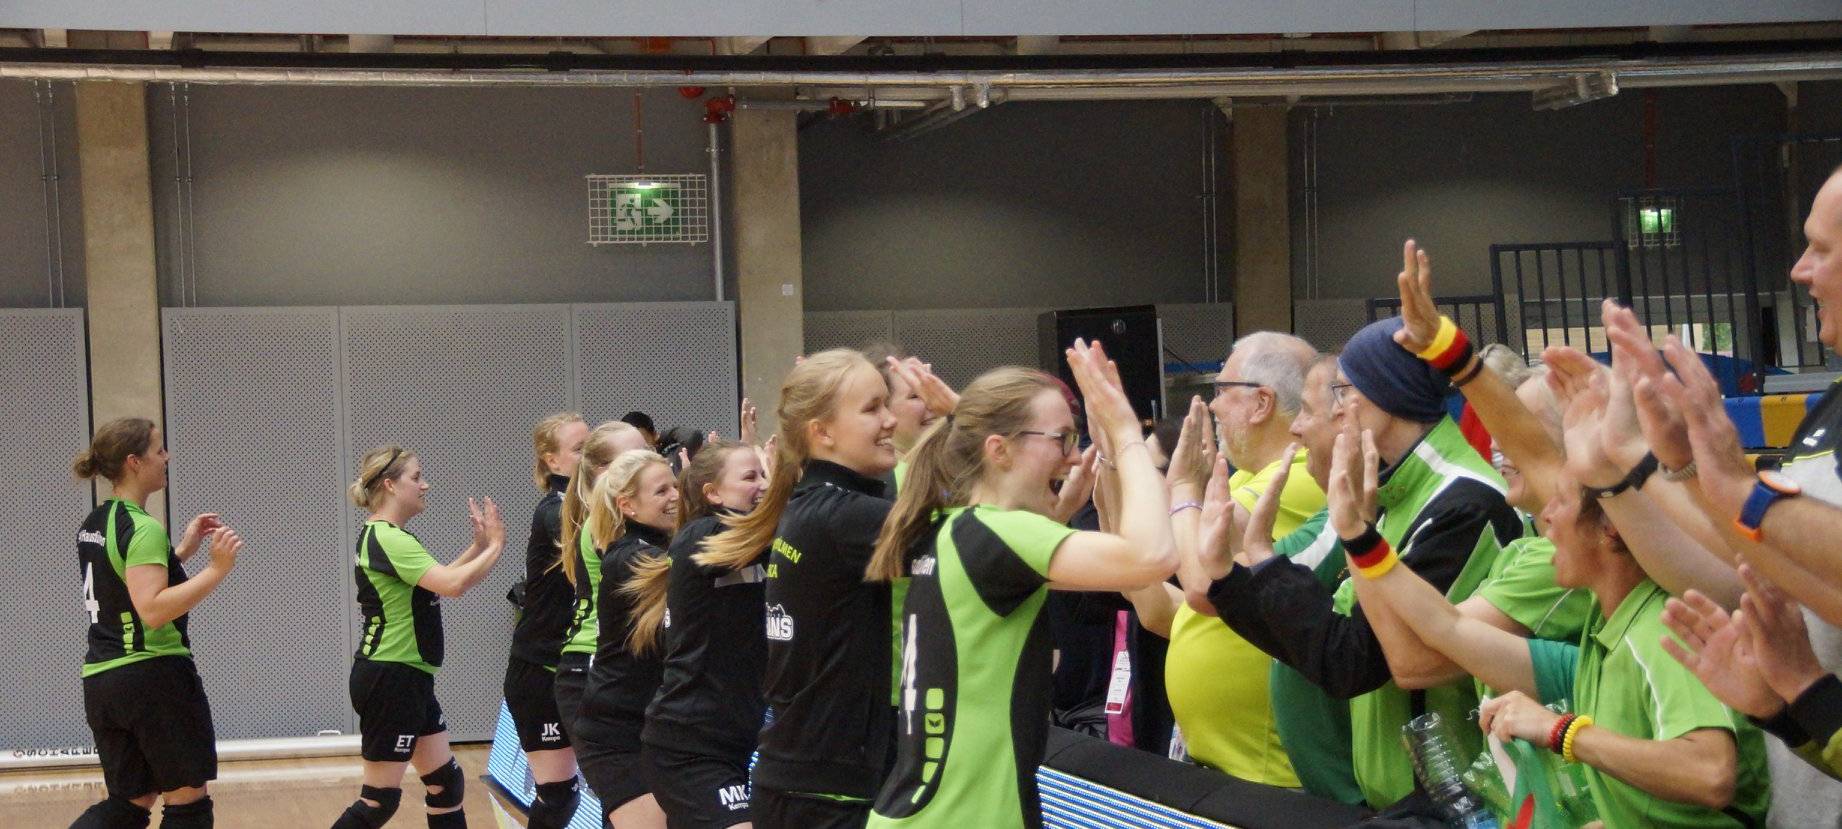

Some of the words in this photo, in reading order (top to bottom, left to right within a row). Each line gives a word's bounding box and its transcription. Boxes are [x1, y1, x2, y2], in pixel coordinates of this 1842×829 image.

[83, 561, 100, 624] 4
[541, 722, 561, 736] JK
[396, 734, 415, 747] ET
[719, 784, 749, 806] MK
